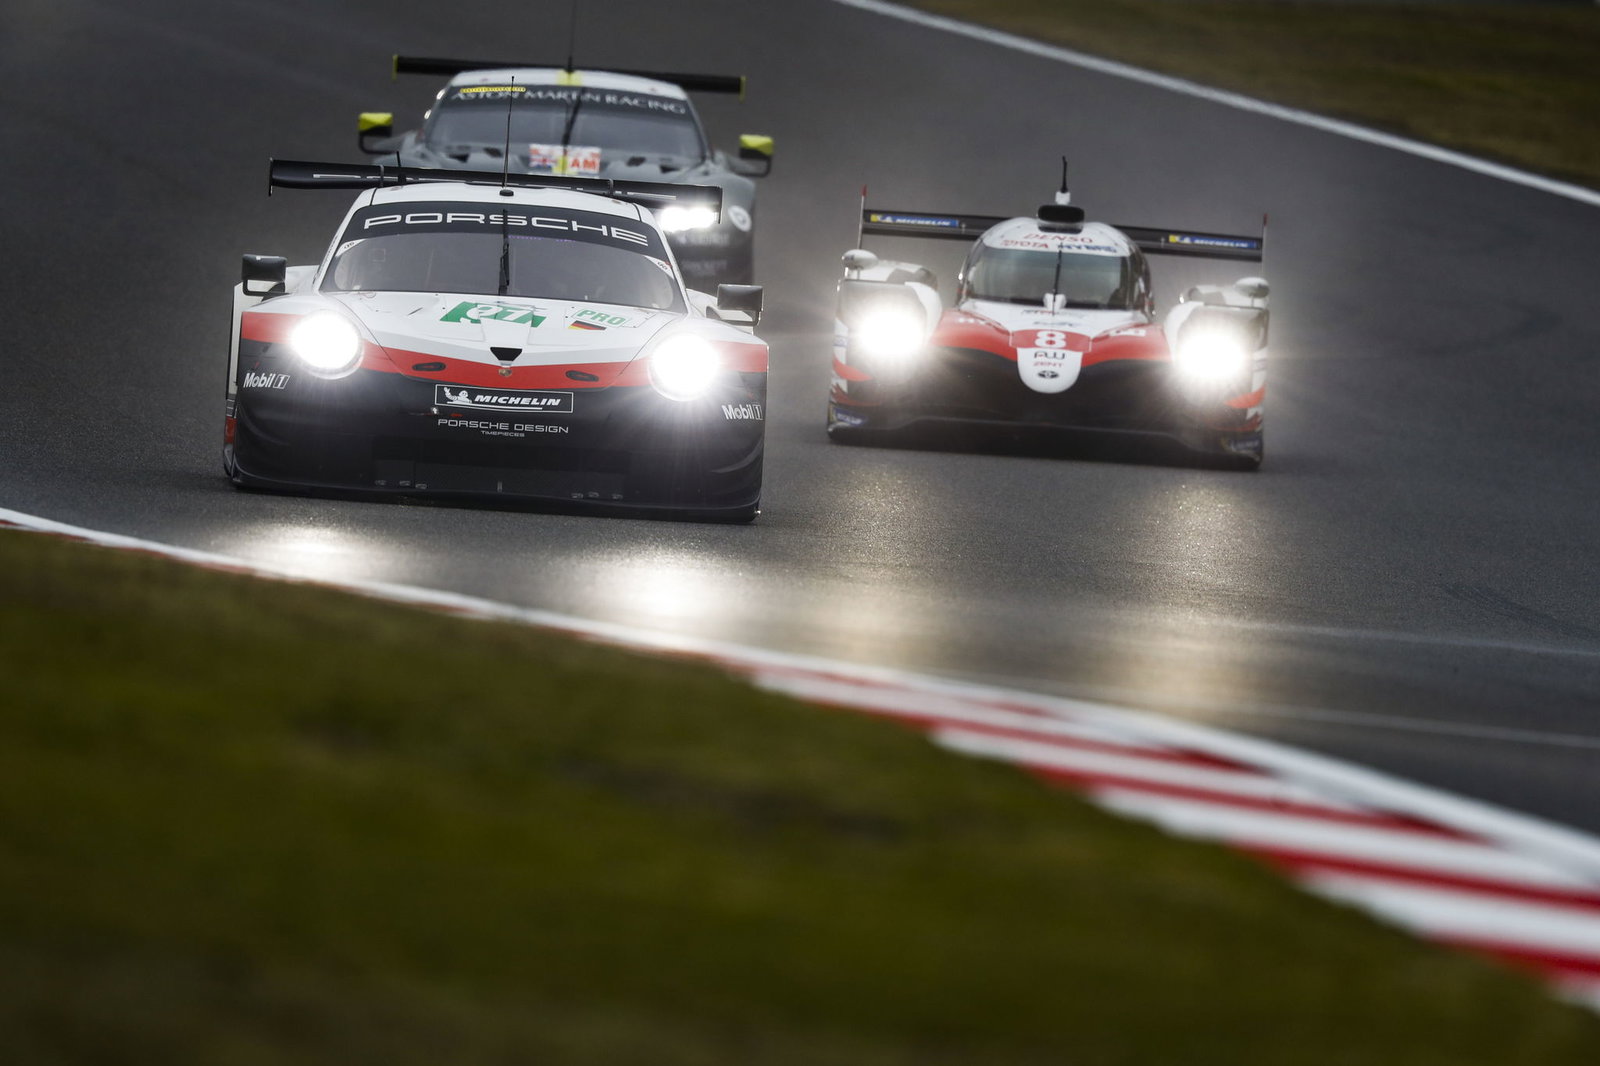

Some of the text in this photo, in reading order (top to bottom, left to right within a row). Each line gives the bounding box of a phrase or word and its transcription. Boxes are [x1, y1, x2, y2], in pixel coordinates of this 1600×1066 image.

[524, 90, 601, 102] MARTIN
[605, 94, 686, 114] RACING
[570, 157, 597, 170] AM
[363, 212, 649, 247] PORSCHE
[1023, 233, 1094, 244] DENSO
[576, 309, 625, 326] PRO
[1034, 331, 1067, 348] 8
[243, 372, 276, 388] Mobil
[474, 394, 561, 406] MICHELIN
[721, 403, 755, 420] Mobil
[437, 418, 569, 434] PORSCHE DESIGN
[480, 430, 525, 438] TIMEPIECES
